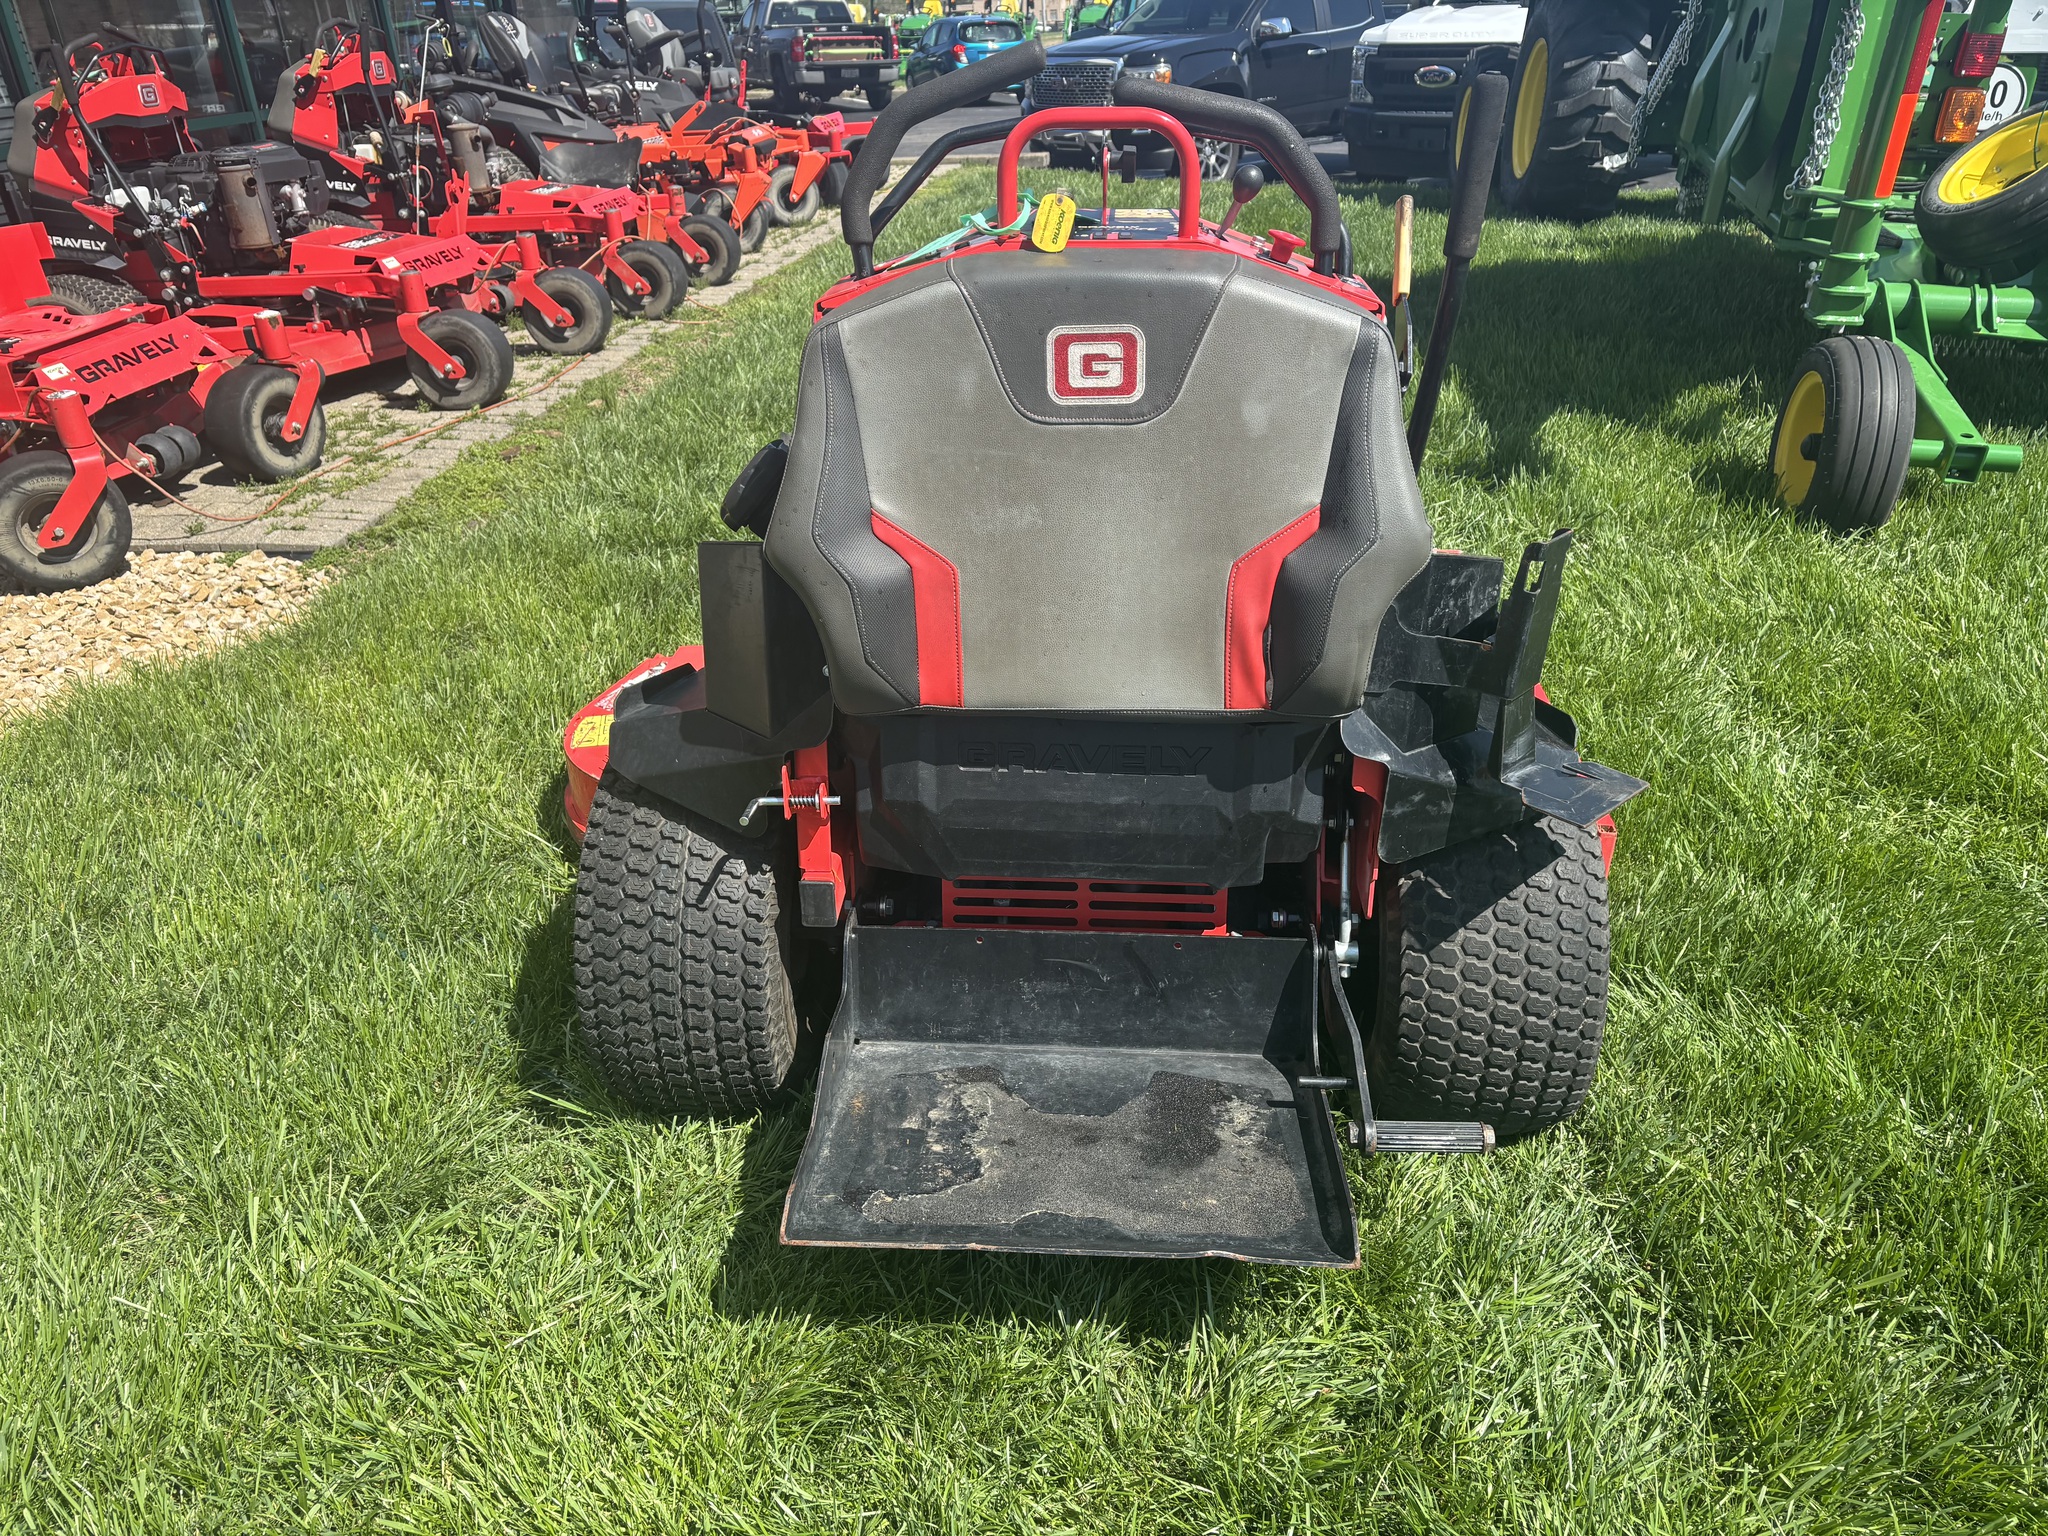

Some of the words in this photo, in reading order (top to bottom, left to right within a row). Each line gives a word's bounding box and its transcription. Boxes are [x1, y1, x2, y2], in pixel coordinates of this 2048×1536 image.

[402, 245, 464, 272] GRAVELY
[74, 333, 180, 383] GRAVELY
[958, 742, 1212, 777] GRAVELY
